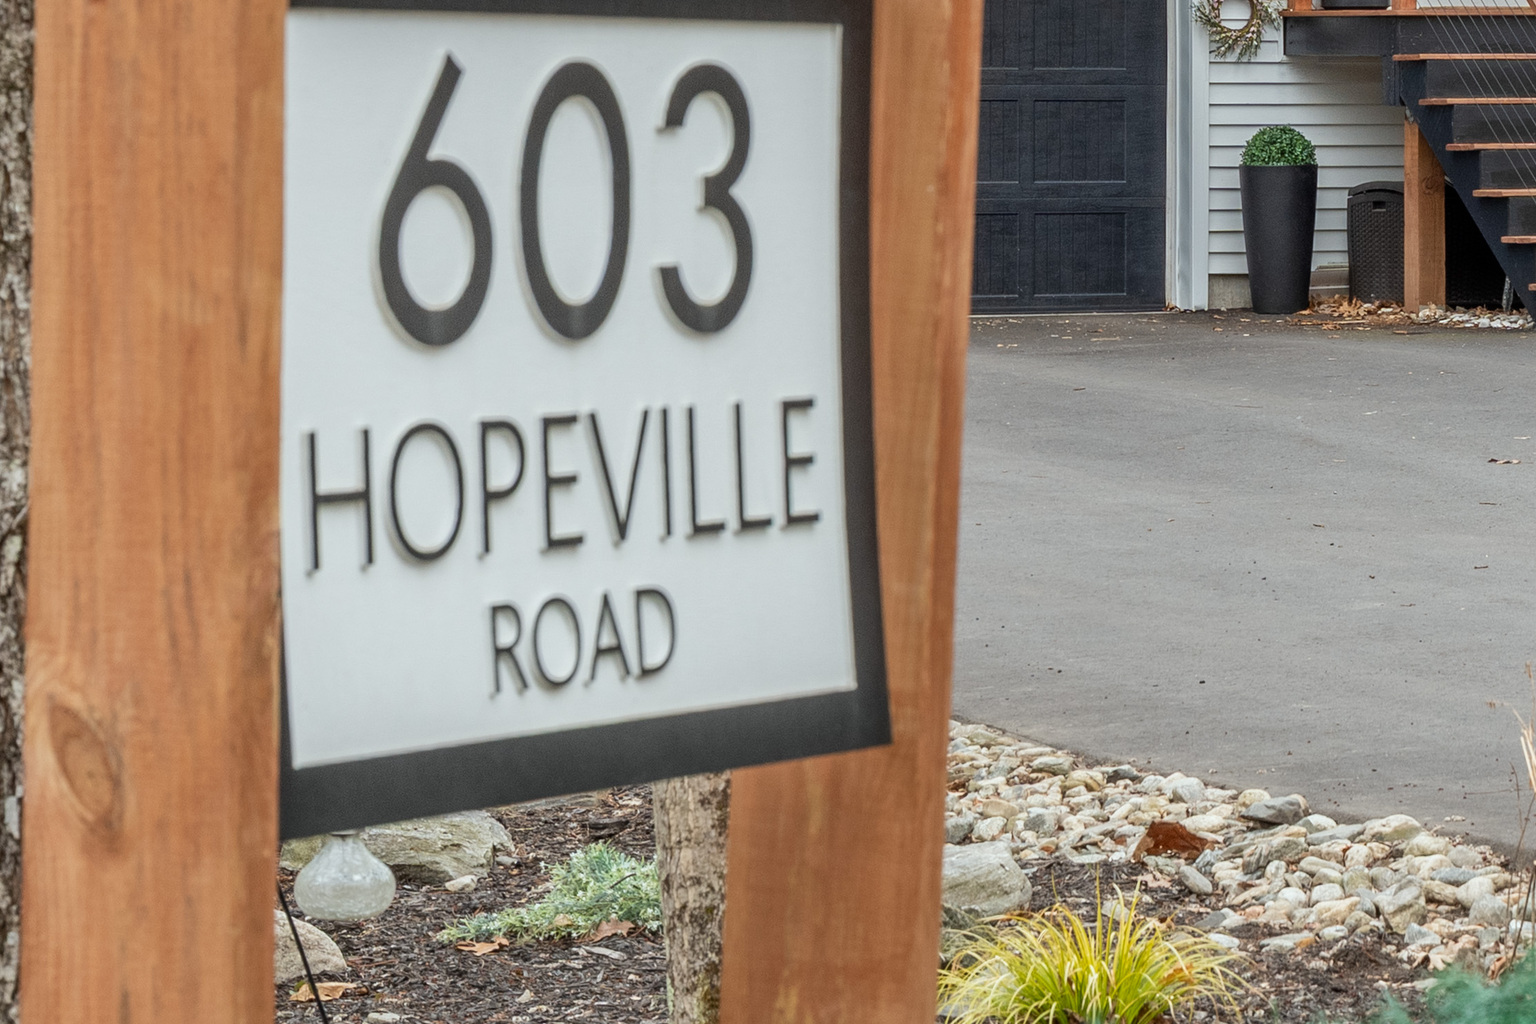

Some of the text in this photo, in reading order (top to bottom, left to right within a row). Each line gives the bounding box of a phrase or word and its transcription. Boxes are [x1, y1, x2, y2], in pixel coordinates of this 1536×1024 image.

[378, 51, 755, 346] 603
[305, 398, 821, 572] HOPEVILLE
[489, 586, 676, 697] ROAD
